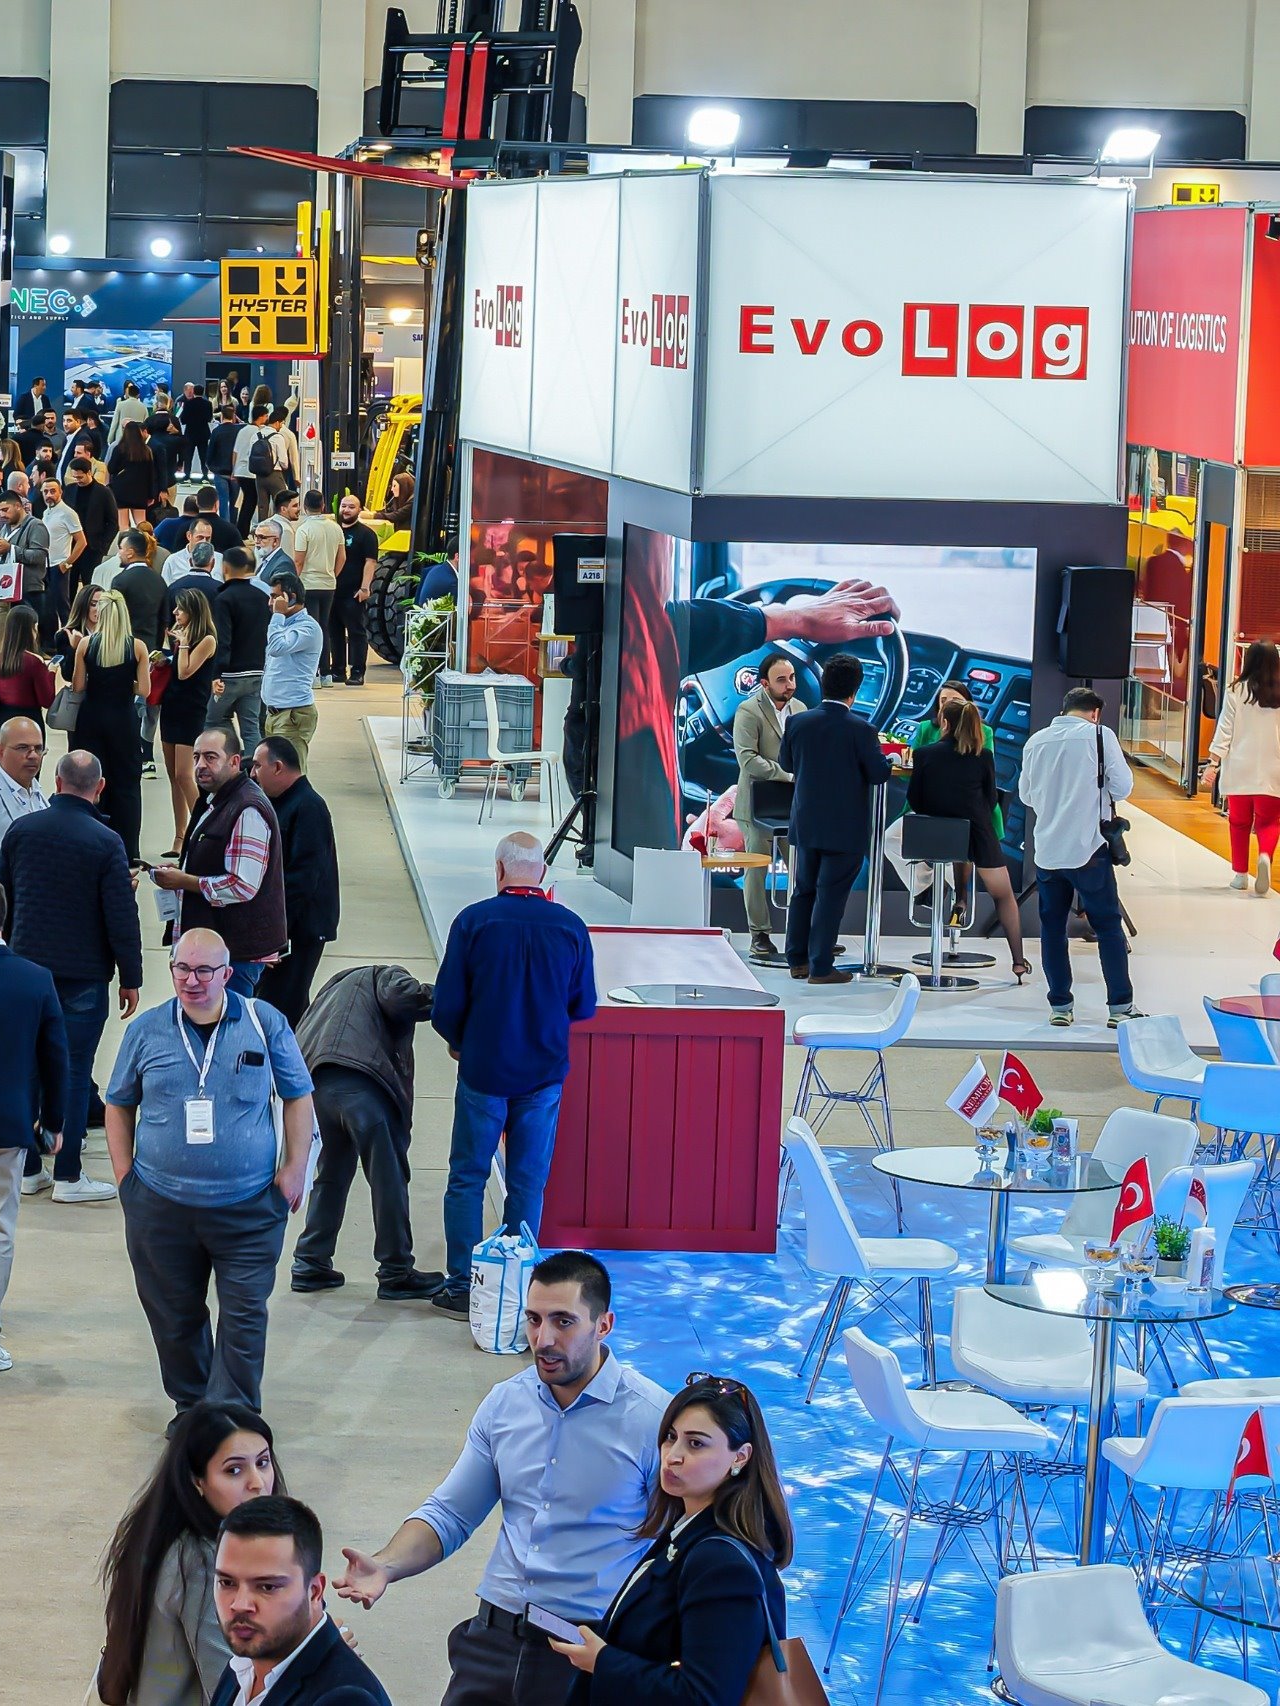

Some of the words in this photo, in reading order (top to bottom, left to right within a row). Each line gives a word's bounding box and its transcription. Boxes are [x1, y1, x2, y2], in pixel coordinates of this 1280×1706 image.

[228, 299, 307, 312] HYSTER
[474, 285, 523, 347] EvoLog
[621, 294, 689, 369] EvoLog
[1128, 310, 1159, 346] UTION
[1160, 311, 1175, 348] OF
[1175, 312, 1227, 354] LOGISTICS
[739, 303, 1089, 380] EvoLog
